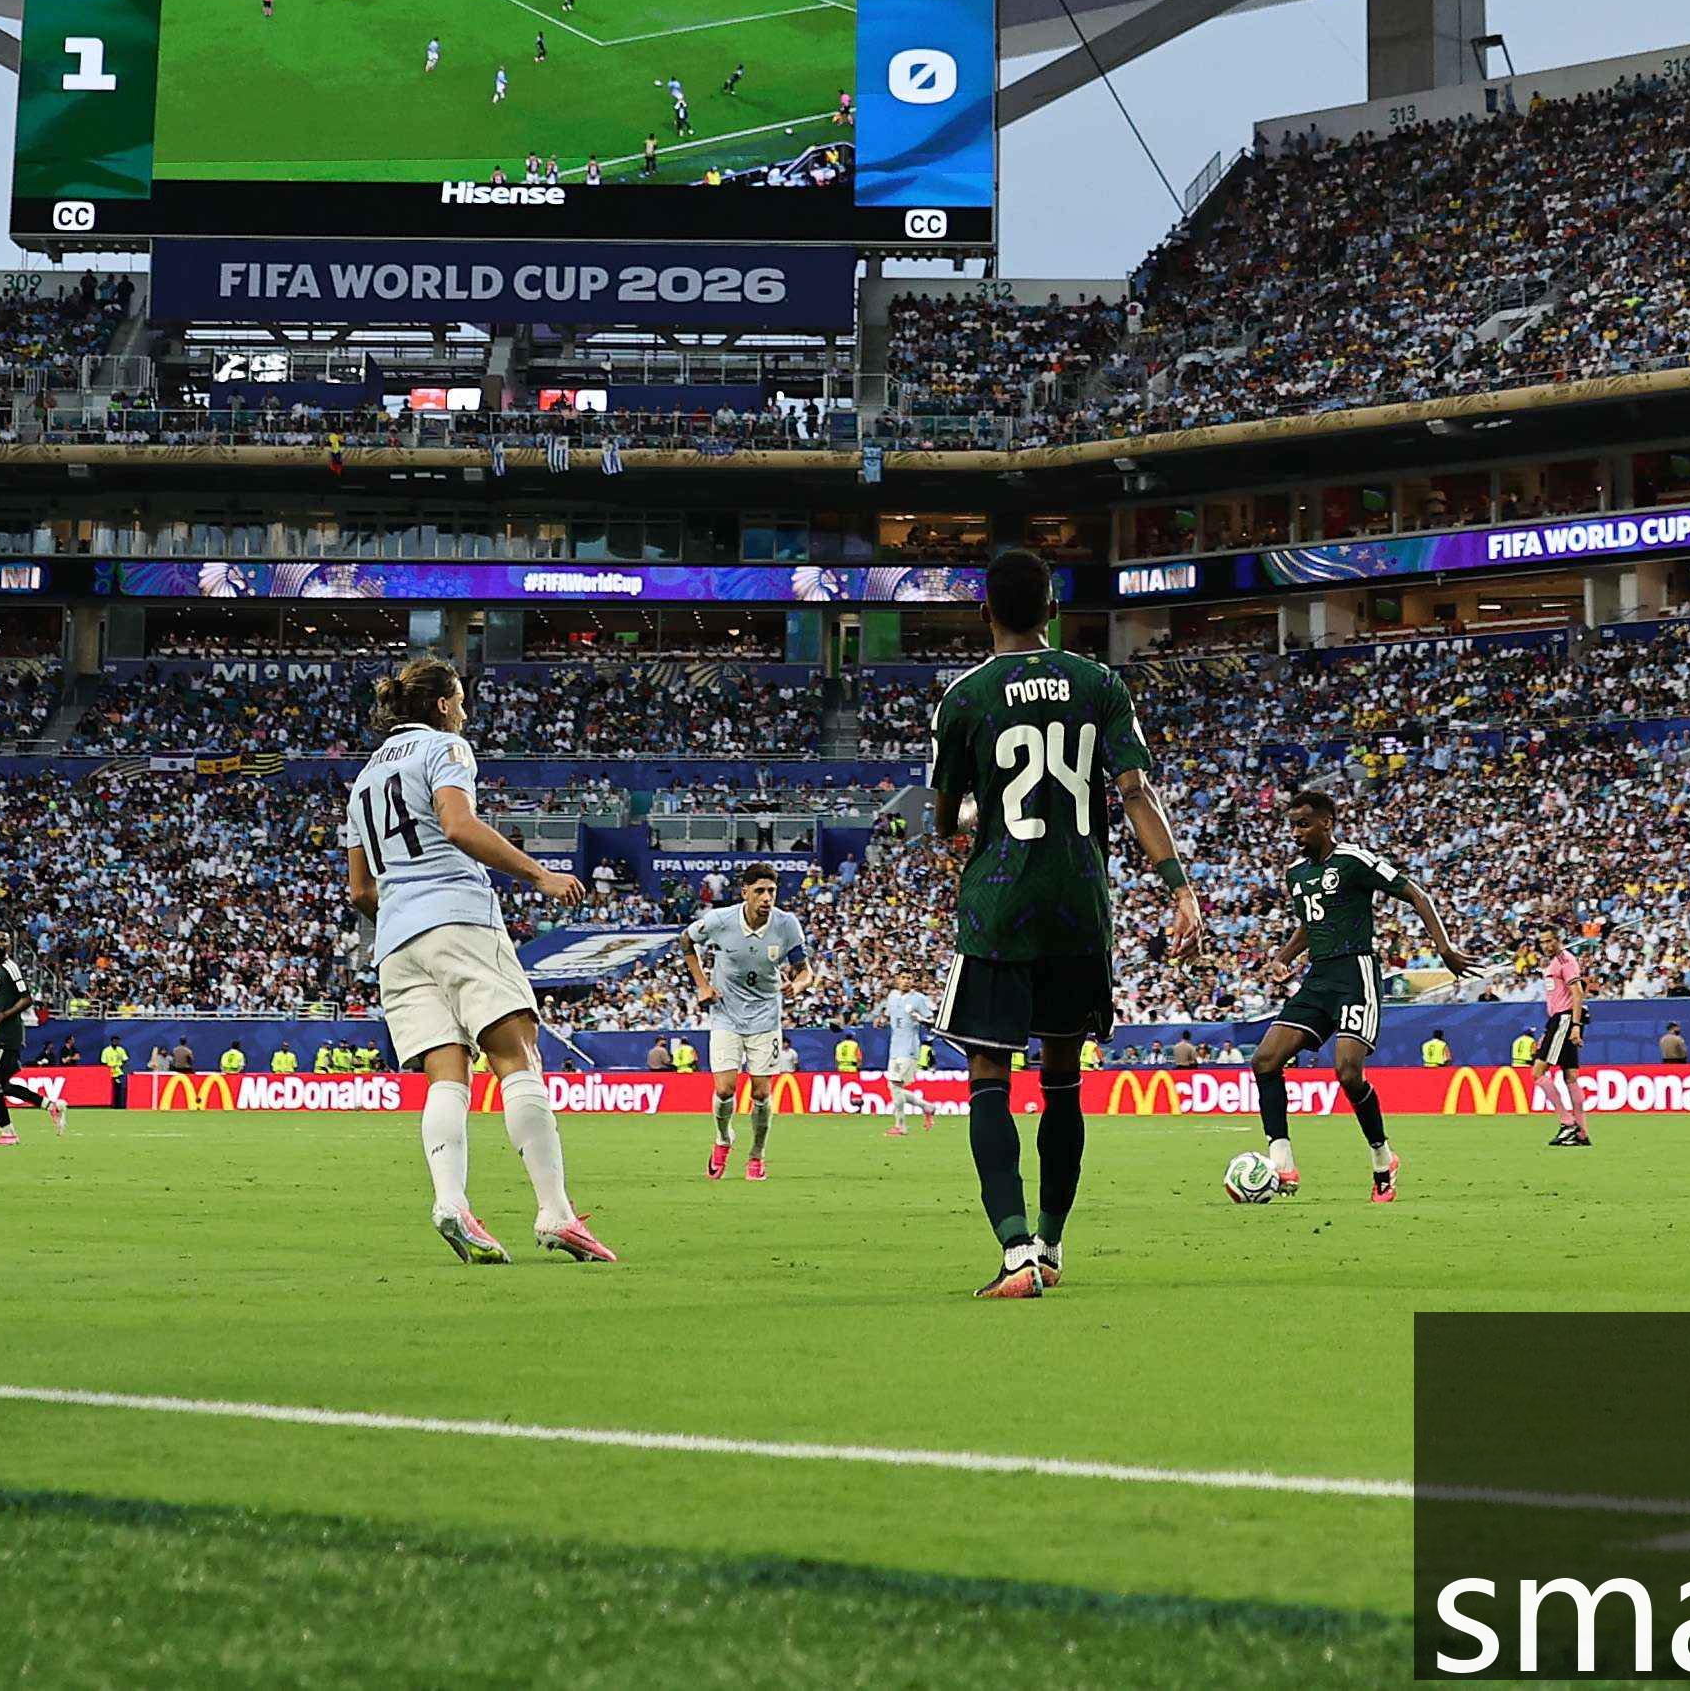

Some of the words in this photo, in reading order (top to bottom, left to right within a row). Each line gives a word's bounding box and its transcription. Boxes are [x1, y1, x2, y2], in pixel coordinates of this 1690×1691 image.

[62, 37, 117, 90] 1
[888, 47, 958, 105] 0
[1389, 104, 1416, 125] 313
[441, 180, 566, 205] Hisense
[58, 207, 90, 226] CC
[911, 215, 942, 234] CC
[4, 273, 42, 293] 309
[218, 261, 322, 299] FIFA
[328, 262, 504, 301] WORLD
[511, 263, 610, 302] CUP
[616, 265, 788, 303] 2026
[1487, 529, 1543, 560] FIFA
[1544, 520, 1639, 554] WORLD
[523, 572, 643, 596] #FIFAWorldCup
[1118, 565, 1196, 595] MIAMI
[1005, 678, 1070, 707] MOTEB
[995, 721, 1096, 840] 24
[359, 771, 424, 875] 14
[536, 858, 574, 871] 026
[652, 859, 683, 871] FIFA
[683, 859, 732, 871] WORLD
[1303, 892, 1325, 923] 15
[747, 971, 757, 987] 8
[1340, 1004, 1365, 1031] 15
[772, 1038, 780, 1059] 8
[236, 1076, 401, 1111] McDonald's
